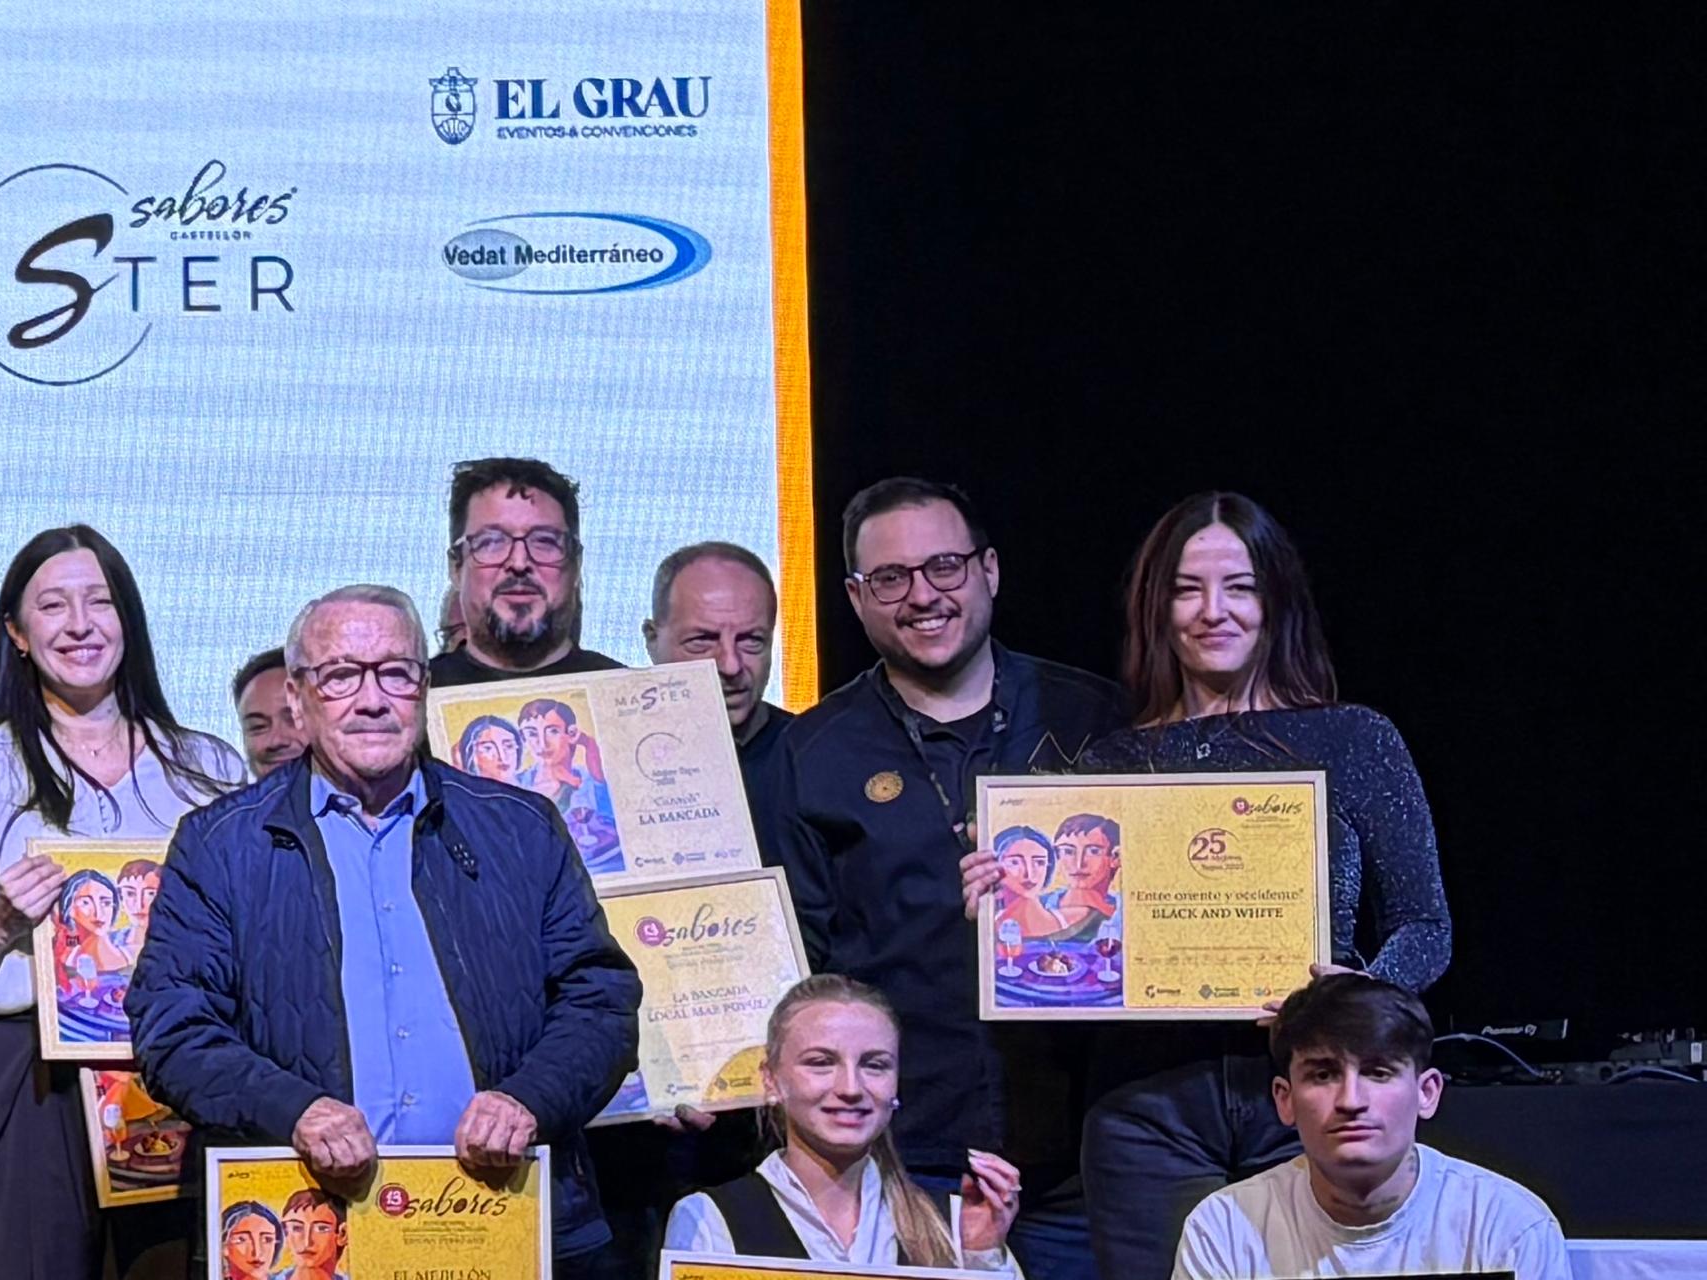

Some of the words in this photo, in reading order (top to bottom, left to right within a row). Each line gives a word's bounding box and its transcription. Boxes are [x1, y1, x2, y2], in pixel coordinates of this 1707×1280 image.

[493, 78, 561, 120] EL
[573, 76, 712, 119] GRAU
[497, 126, 567, 139] EVENTOS
[581, 125, 697, 139] CONVENCIONES
[444, 245, 506, 265] Vedat
[514, 243, 664, 265] Mediterráneo
[1190, 832, 1226, 862] 25
[1152, 907, 1198, 919] BLACK
[1201, 907, 1232, 919] AND
[1236, 906, 1284, 919] WHITE
